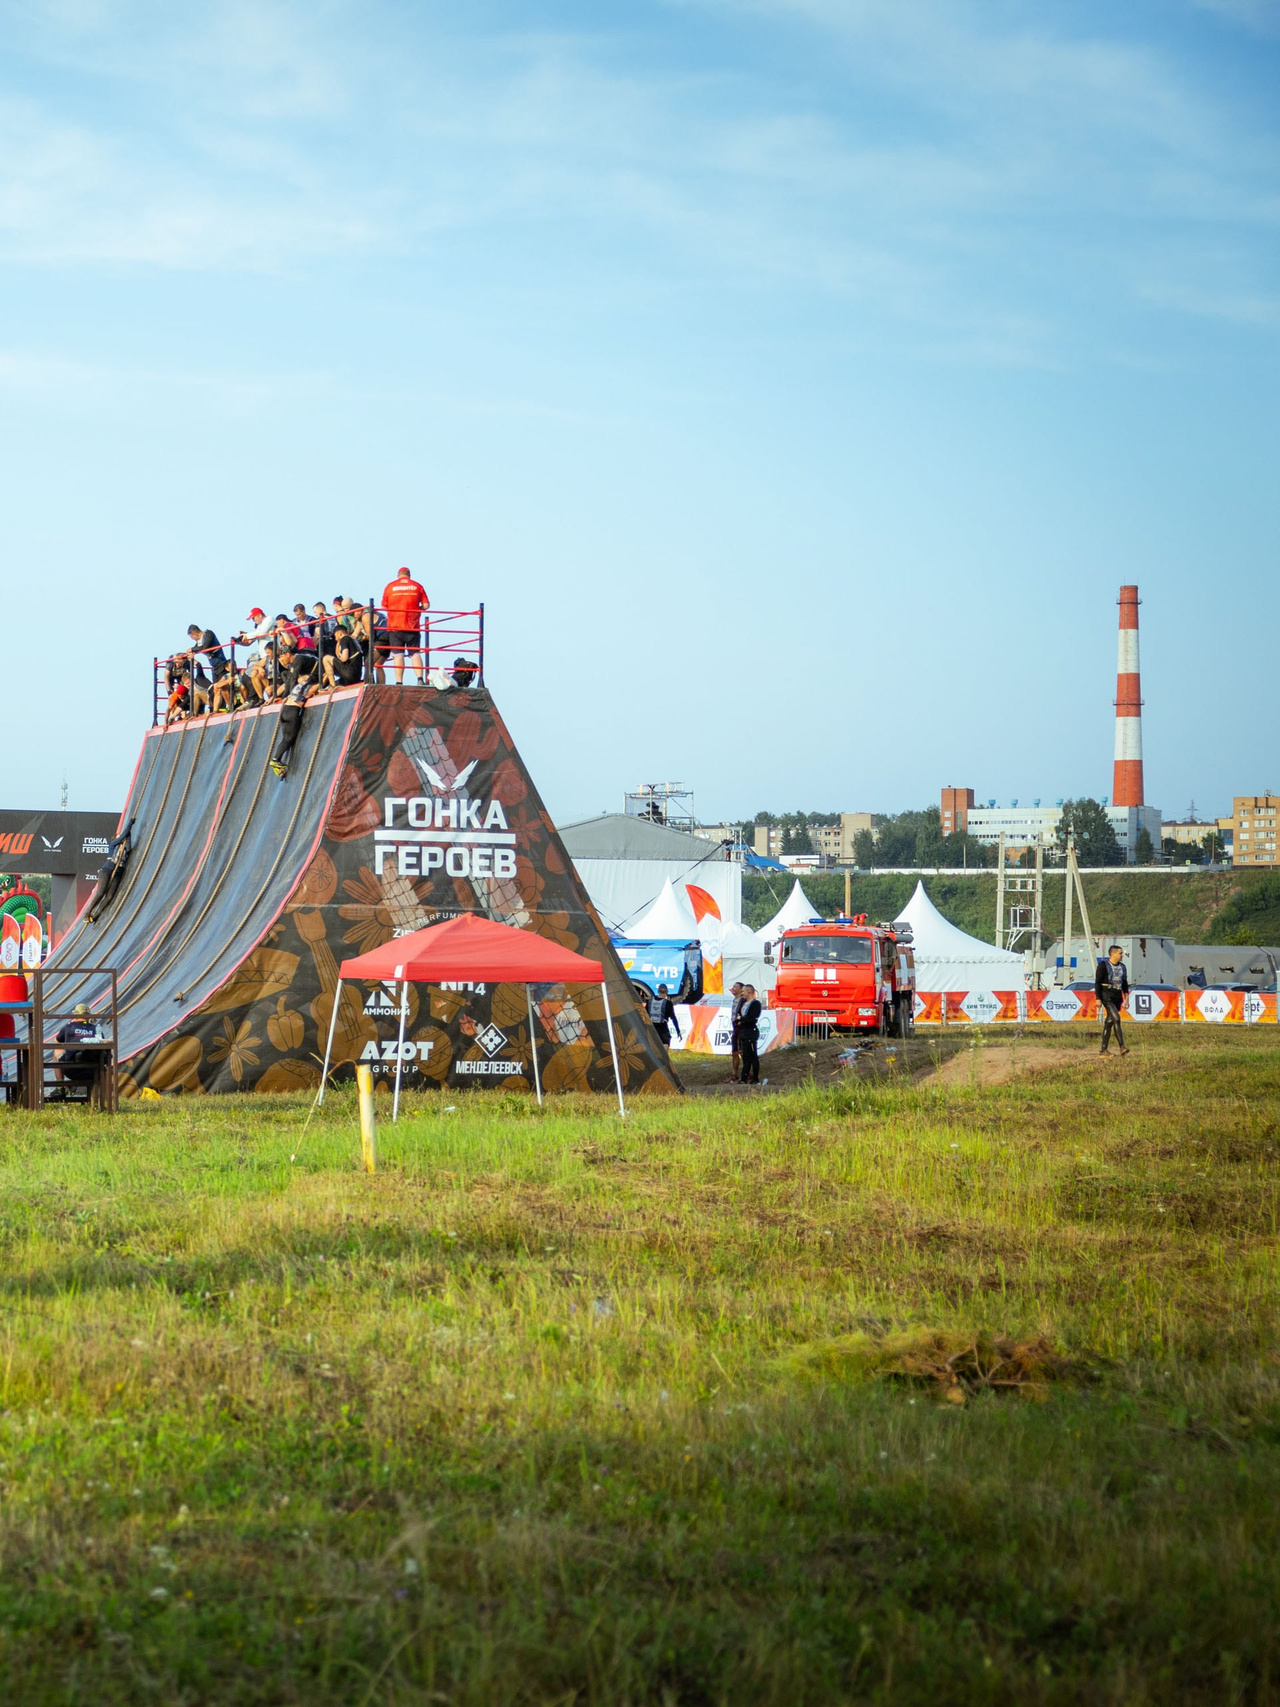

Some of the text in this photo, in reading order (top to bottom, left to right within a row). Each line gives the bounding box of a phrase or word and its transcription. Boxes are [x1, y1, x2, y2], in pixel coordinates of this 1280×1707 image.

[384, 797, 508, 829] ГОНКА
[374, 845, 517, 878] ГЕРОЕВ
[653, 966, 679, 978] VTB
[363, 1007, 410, 1016] АММОНИЙ
[360, 1040, 434, 1061] AZOT
[372, 1065, 419, 1074] GROUP
[456, 1061, 523, 1075] МЕНДЕЛЕЕВСК
